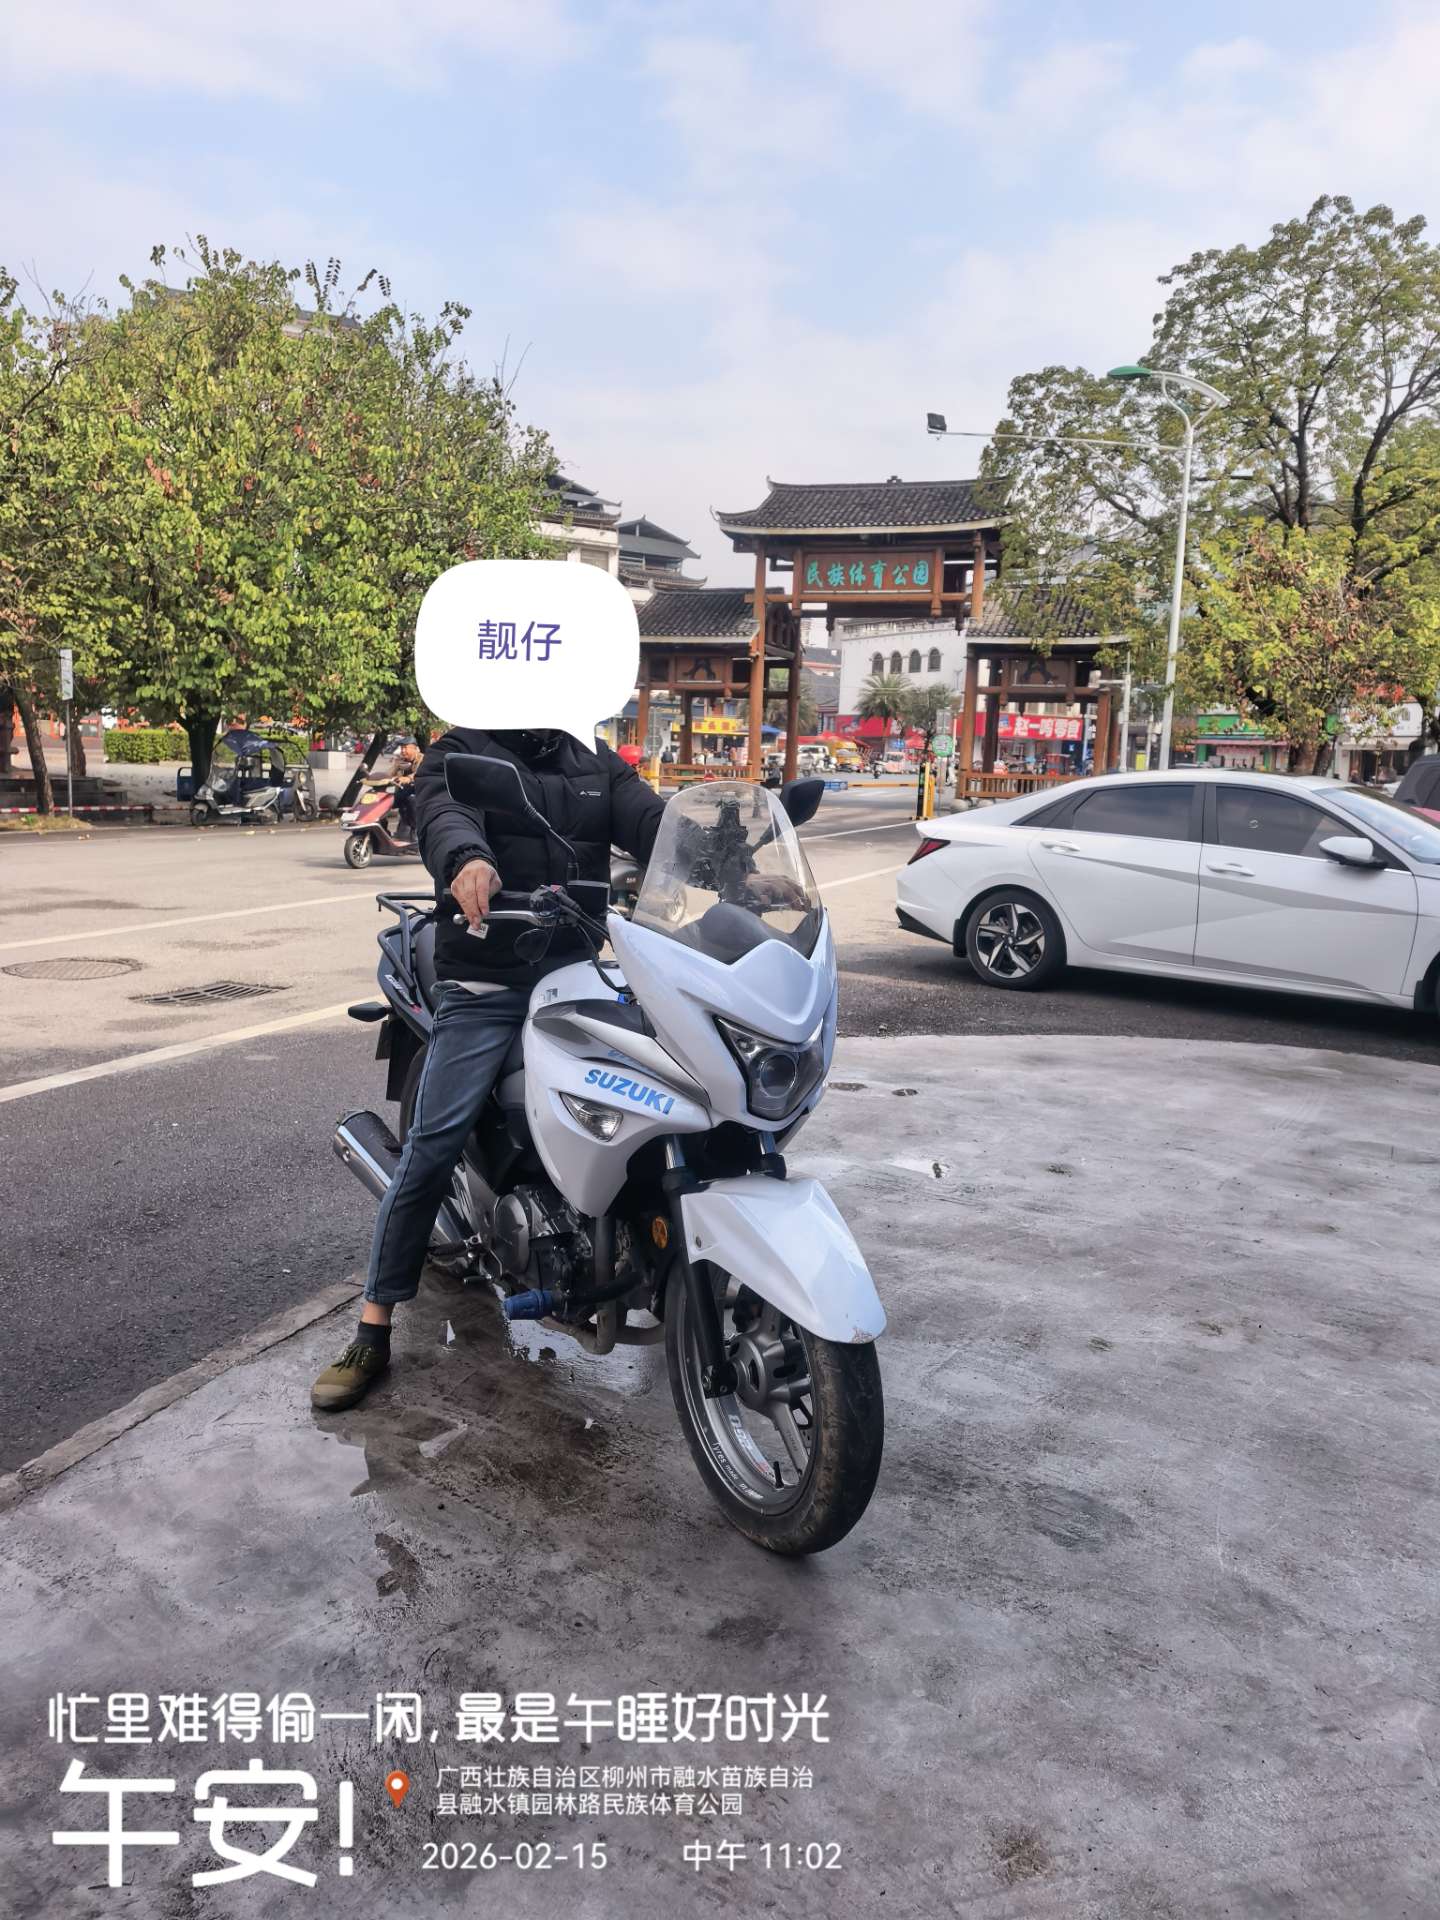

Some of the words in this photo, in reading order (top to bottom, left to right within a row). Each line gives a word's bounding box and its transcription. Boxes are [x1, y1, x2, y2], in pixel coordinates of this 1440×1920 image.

[806, 559, 930, 589] 民族体育公园
[584, 1068, 676, 1115] SUZUKI
